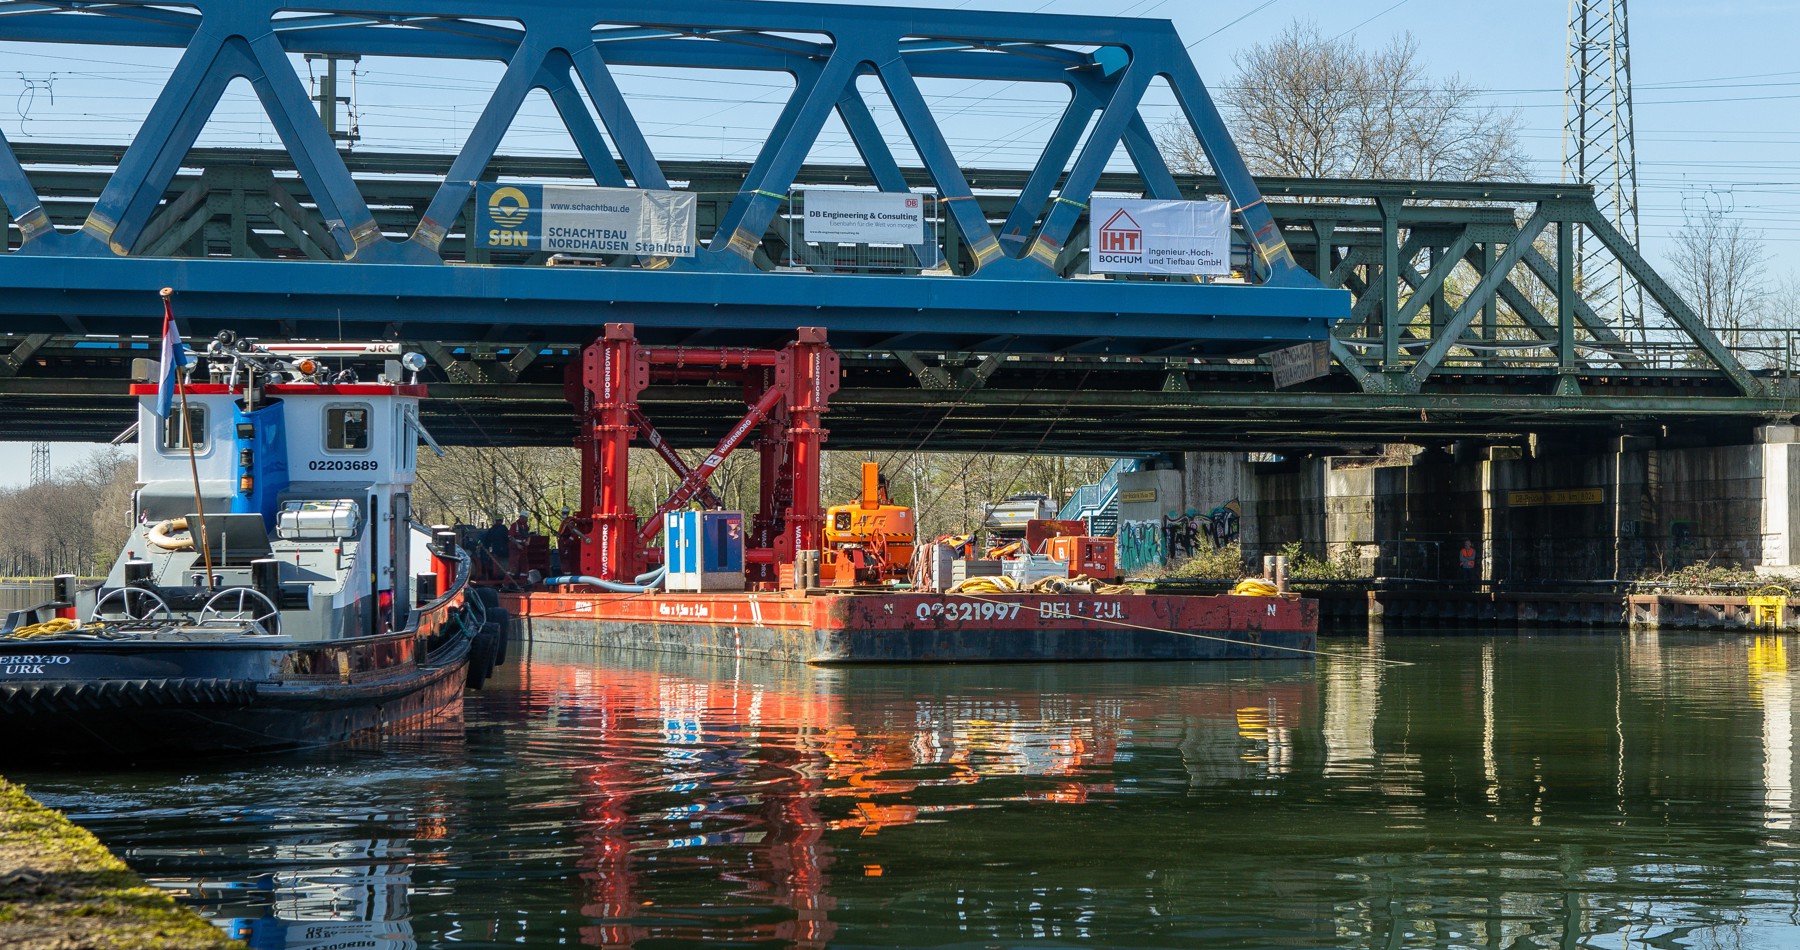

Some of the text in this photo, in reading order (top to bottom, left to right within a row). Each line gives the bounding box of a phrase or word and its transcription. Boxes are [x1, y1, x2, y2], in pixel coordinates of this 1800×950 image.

[550, 202, 630, 213] www.schachtbau.de
[905, 199, 917, 207] DB
[809, 210, 821, 218] DB
[822, 211, 869, 220] Engineering
[877, 212, 918, 221] Consulting
[865, 220, 874, 228] die
[488, 229, 528, 247] SBN
[548, 227, 627, 240] SCHACHTBAU
[548, 238, 629, 251] NORDHAUSEN
[1102, 231, 1139, 251] IHT
[635, 242, 691, 254] Stahlbau
[1099, 255, 1142, 264] BOCHUM
[1166, 258, 1195, 266] Tiefbau
[1197, 258, 1222, 266] GmbH
[369, 344, 394, 353] JRC
[719, 419, 752, 454] WAGENBORG
[660, 444, 688, 475] WAGENBOR
[308, 460, 378, 471] 02203689
[1267, 603, 1277, 617] N
[5, 664, 46, 675] URK
